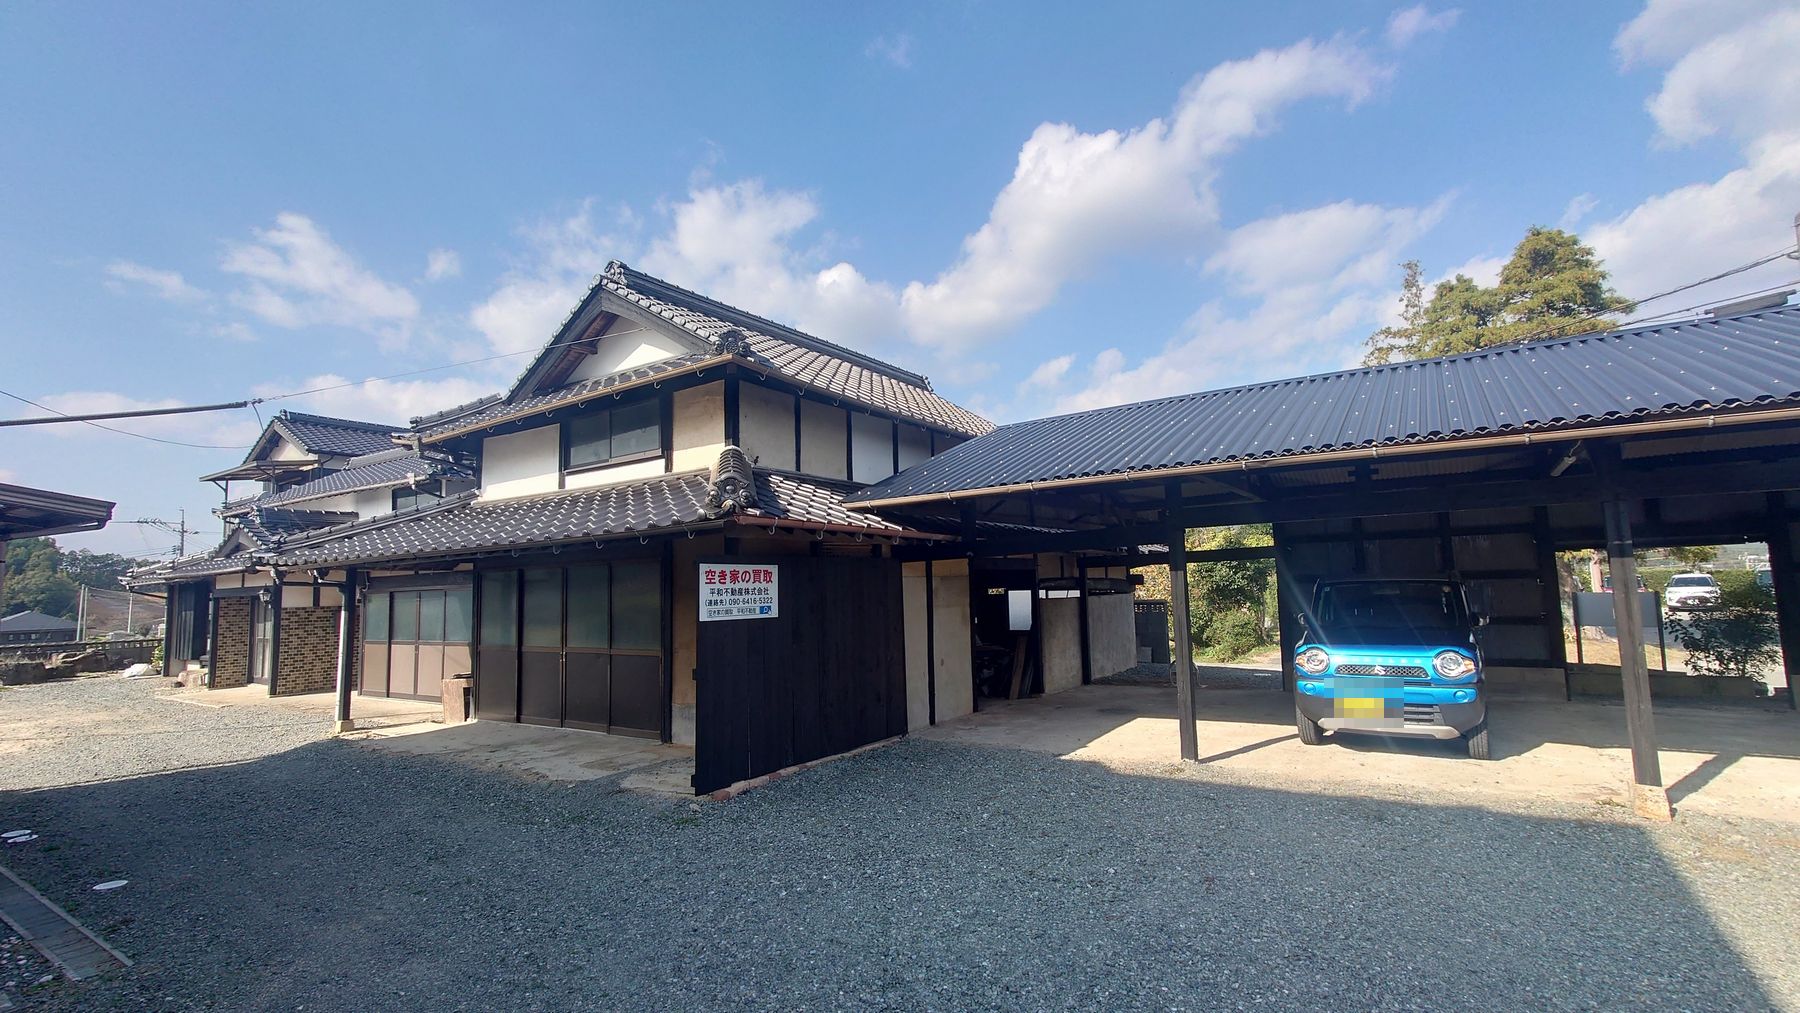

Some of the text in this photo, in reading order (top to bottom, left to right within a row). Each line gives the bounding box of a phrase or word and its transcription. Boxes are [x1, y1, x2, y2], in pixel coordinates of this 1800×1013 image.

[704, 568, 773, 585] 空き家の買取
[709, 587, 770, 597] 平和不動産株式会社
[728, 597, 773, 606] 090-6416-5322
